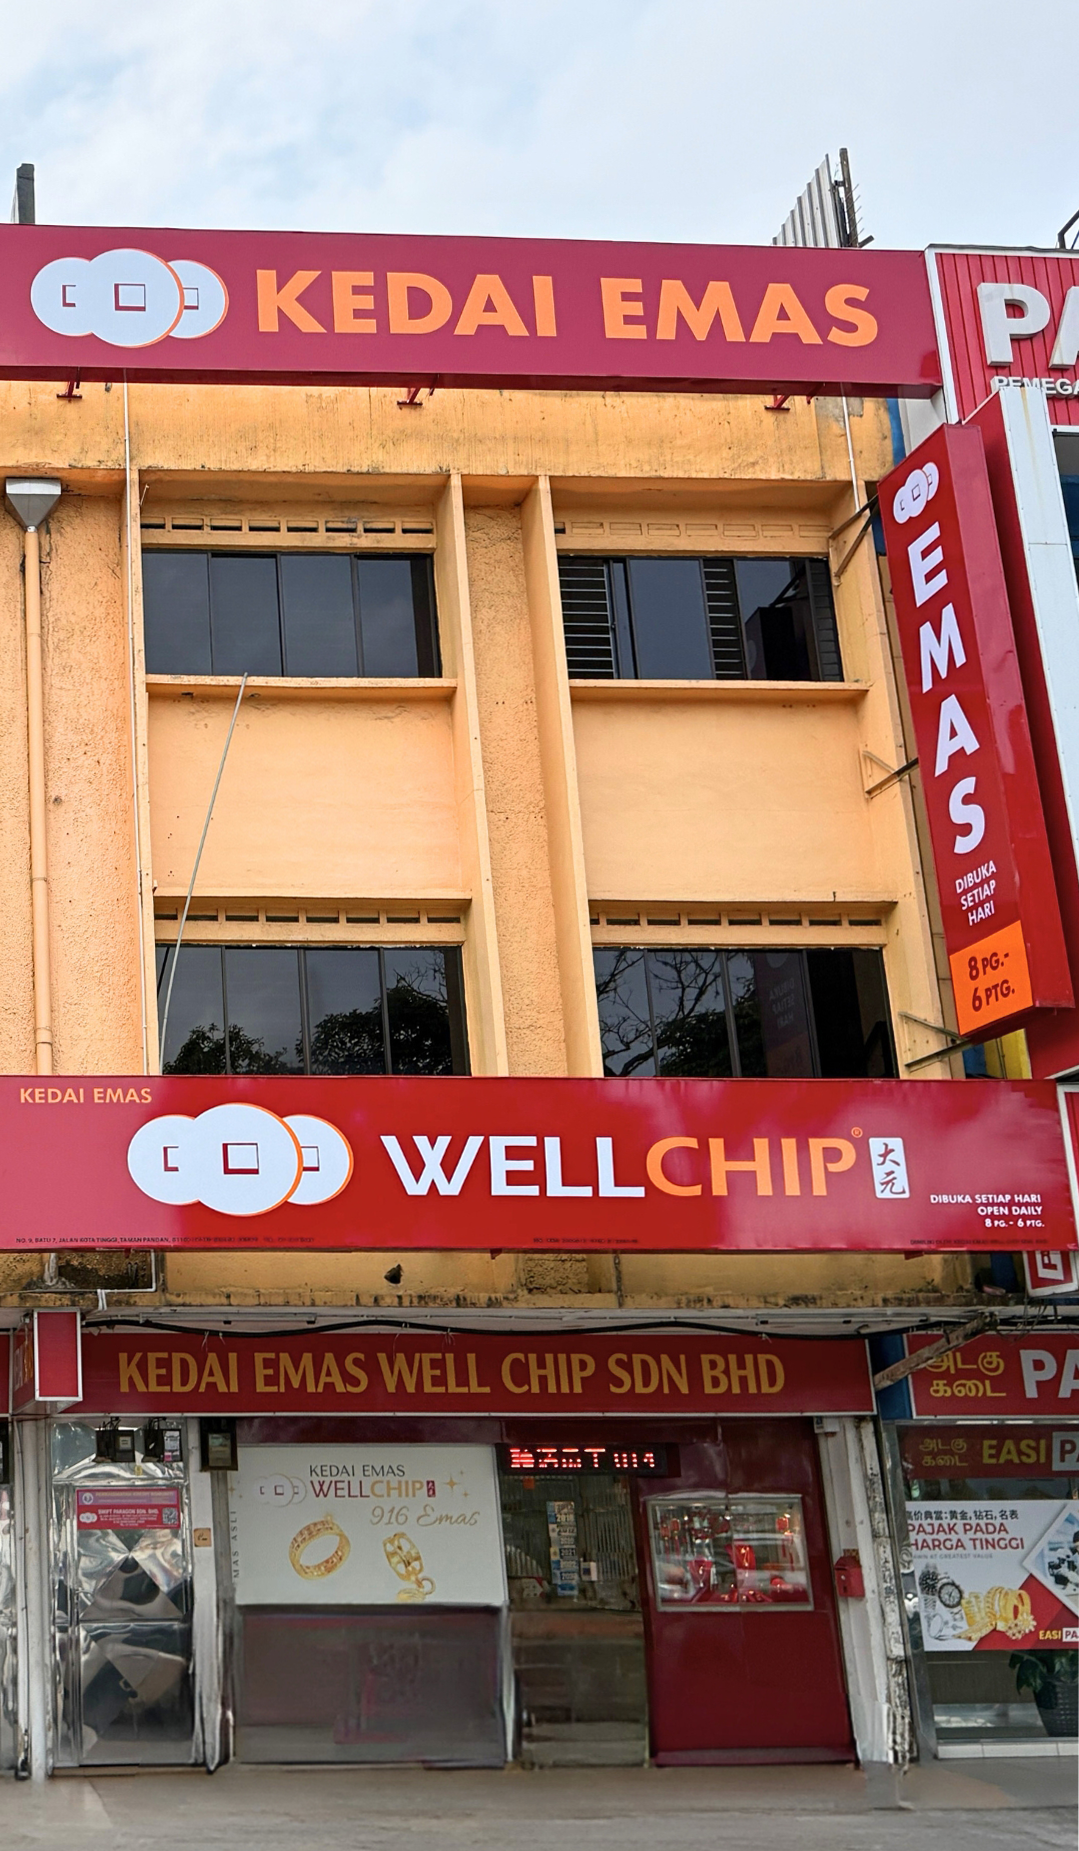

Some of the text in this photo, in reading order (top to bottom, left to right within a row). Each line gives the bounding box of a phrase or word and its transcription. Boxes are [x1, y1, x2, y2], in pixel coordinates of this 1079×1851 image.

[256, 268, 879, 347] KEDAI EMAS
[908, 521, 986, 854] EMAS
[955, 860, 997, 894] DIBUKA
[960, 880, 996, 911] SETIAP
[968, 900, 995, 927] HARI
[968, 956, 979, 981] 8
[972, 979, 1015, 1012] 6 PTG.
[20, 1088, 153, 1104] KEDAI EMAS
[930, 1194, 1042, 1205] DIBUKA SETIAP HARI
[977, 1206, 1043, 1217] OPEN DAILY
[985, 1218, 993, 1229] 8
[1017, 1218, 1025, 1229] 6
[1027, 1219, 1045, 1229] PTG.
[119, 1352, 785, 1394] KEDAI EMAS WELL CHIP SDN BHD
[929, 1379, 1007, 1398] கடை
[982, 1439, 1079, 1465] EASI P
[309, 1464, 405, 1477] KEDAI EMAS
[370, 1504, 480, 1527] 916 Emas
[907, 1522, 1009, 1535] PAJAK PADA
[910, 1537, 1025, 1551] HARGA TINGGI
[1039, 1630, 1062, 1640] EASI
